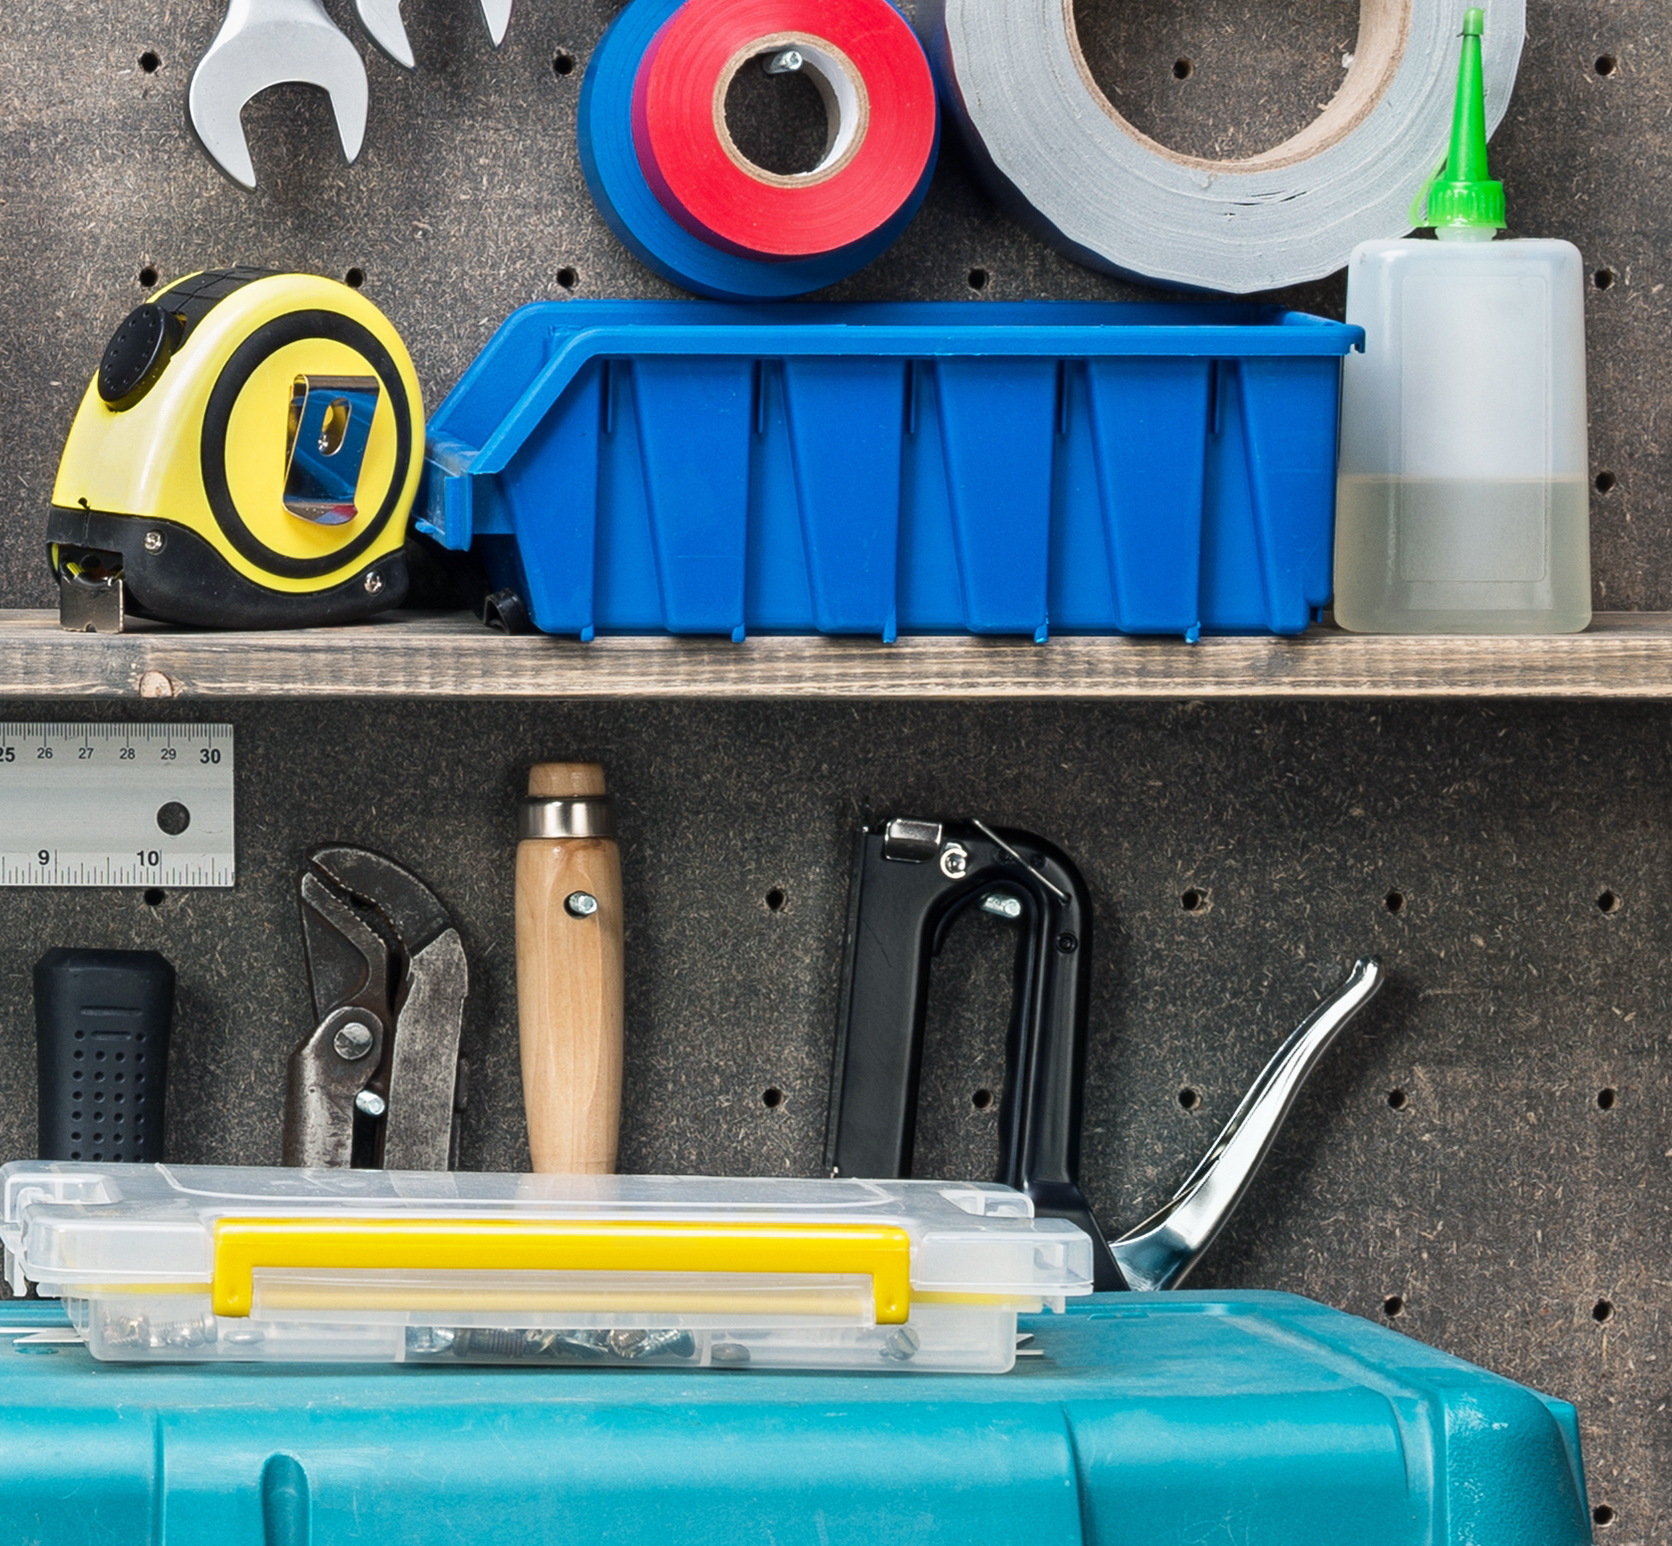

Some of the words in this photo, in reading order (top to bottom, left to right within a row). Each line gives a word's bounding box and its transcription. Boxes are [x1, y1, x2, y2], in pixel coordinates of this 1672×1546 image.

[37, 748, 54, 759] 26
[78, 748, 94, 759] 27
[119, 748, 136, 759] 28
[160, 748, 177, 760] 29
[199, 748, 221, 764] 30
[37, 850, 50, 865] 9
[136, 850, 159, 866] 10
